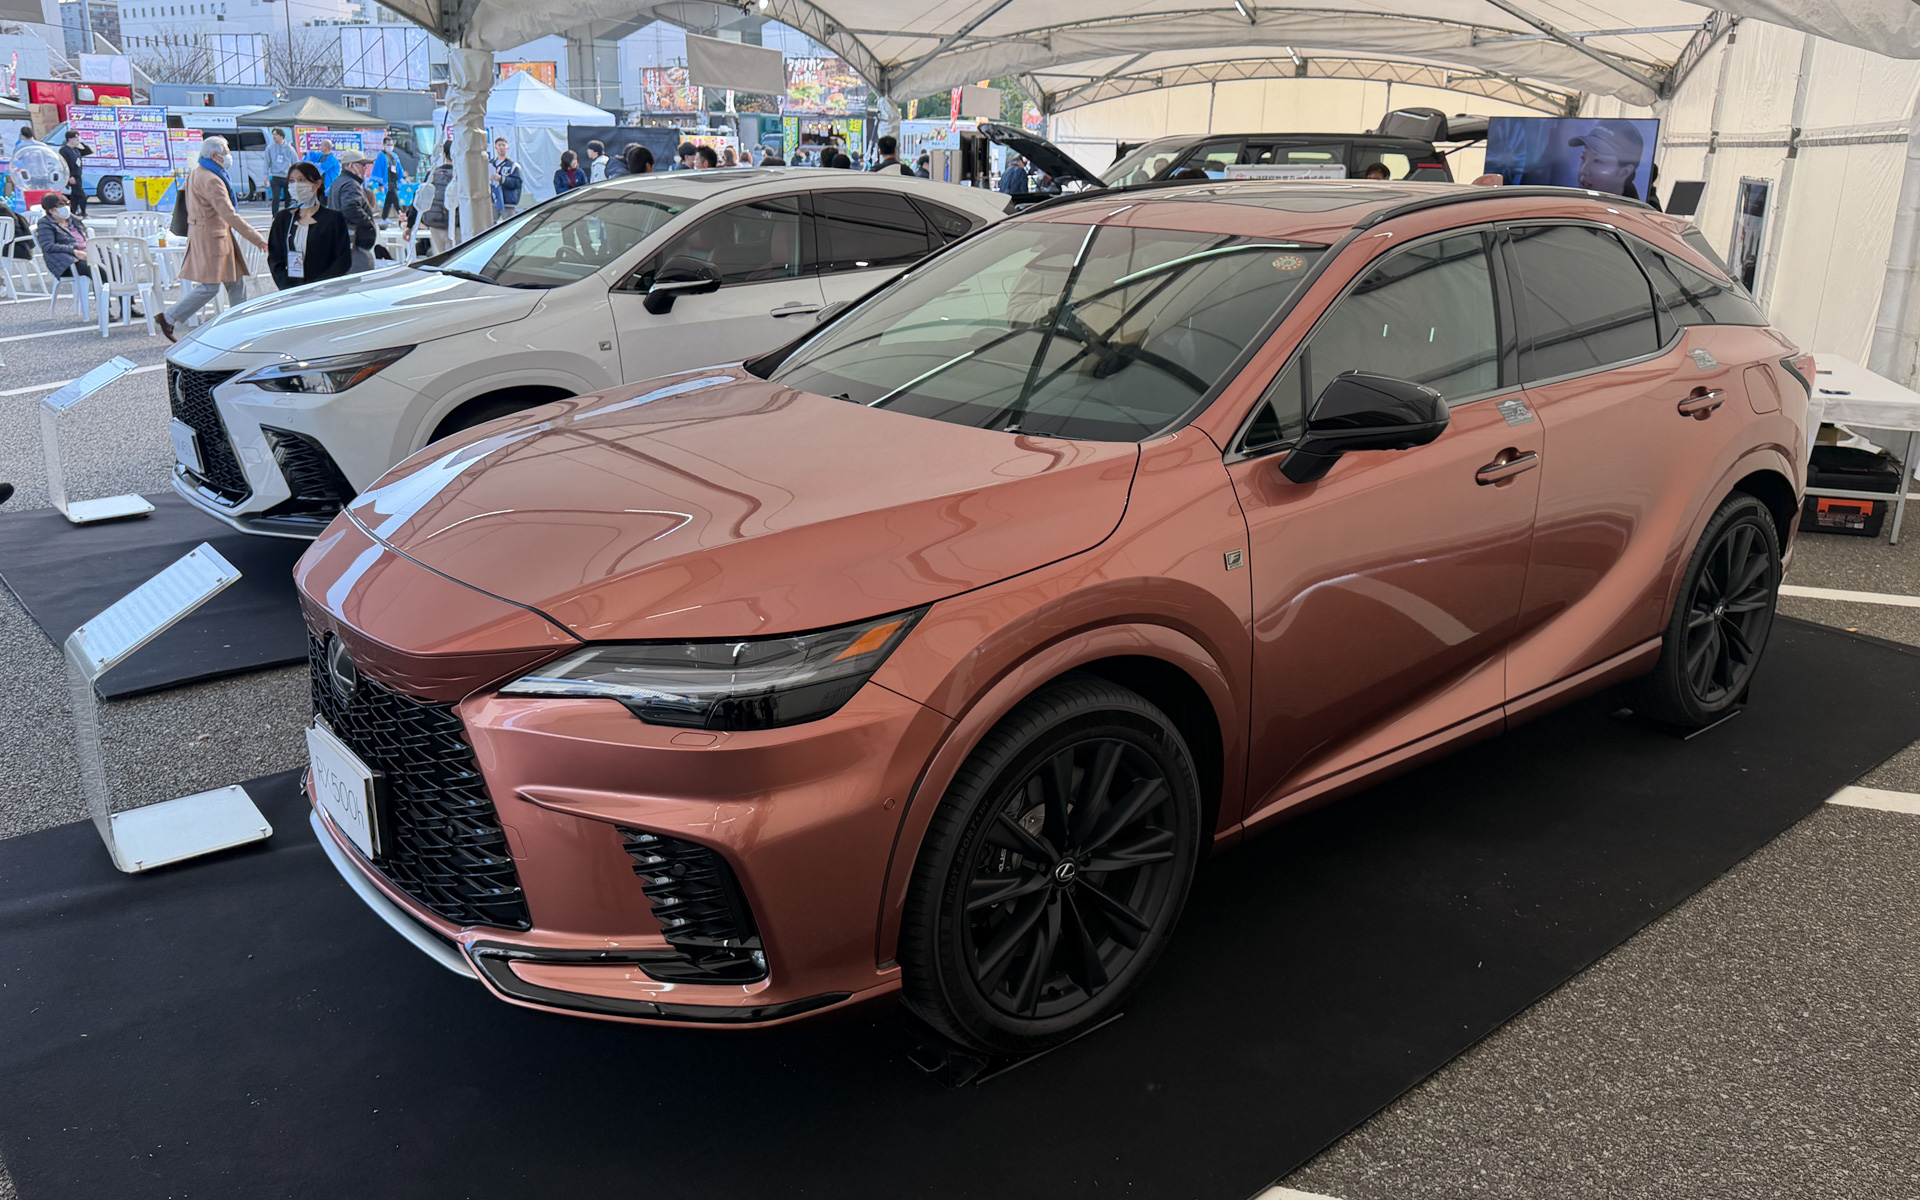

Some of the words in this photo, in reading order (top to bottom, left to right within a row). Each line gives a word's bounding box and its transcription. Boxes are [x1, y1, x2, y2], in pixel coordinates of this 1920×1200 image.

[786, 58, 824, 72] アメリカン
[790, 71, 819, 84] バーガー
[957, 820, 977, 863] SPORT
